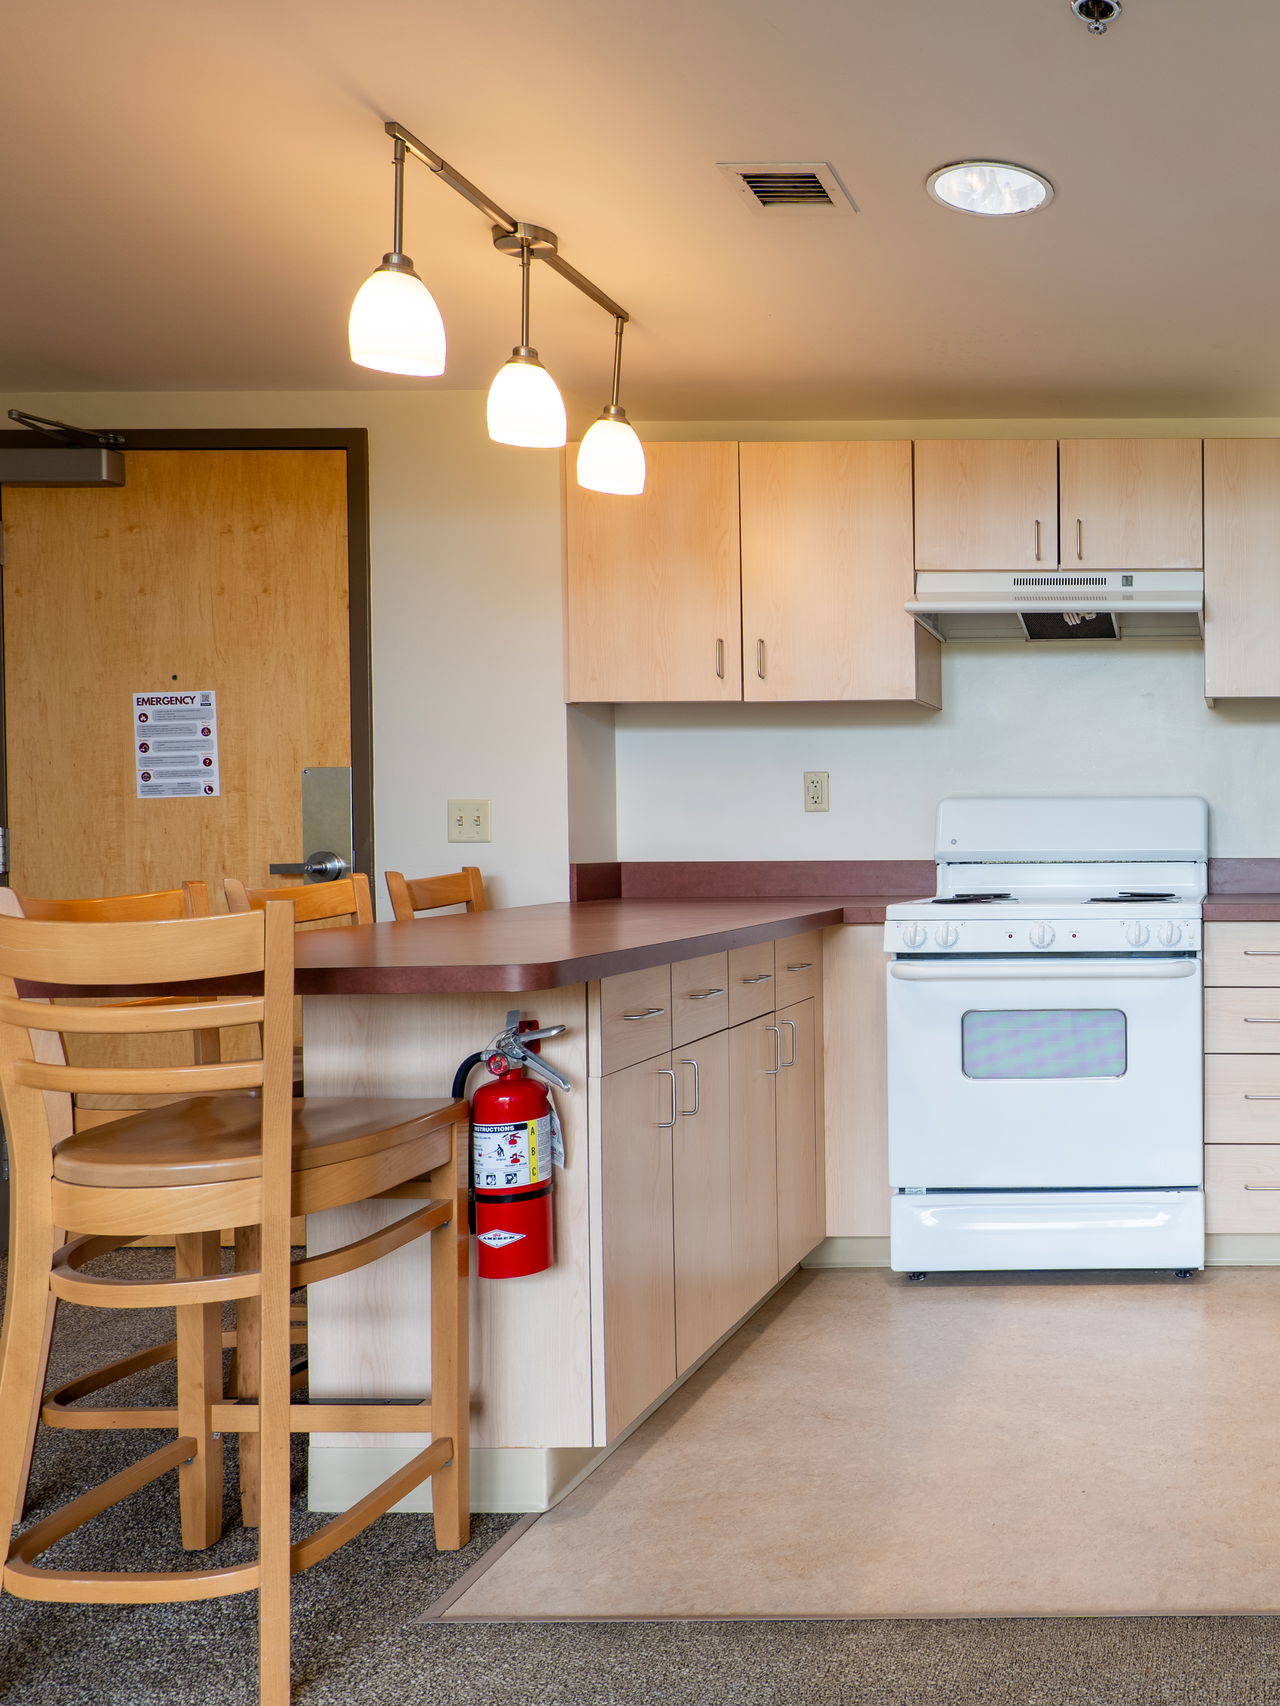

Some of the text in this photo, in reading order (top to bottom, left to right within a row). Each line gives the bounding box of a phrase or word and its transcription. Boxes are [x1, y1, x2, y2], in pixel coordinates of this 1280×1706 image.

[136, 696, 196, 706] EMERGENCY
[531, 1126, 536, 1176] A B C
